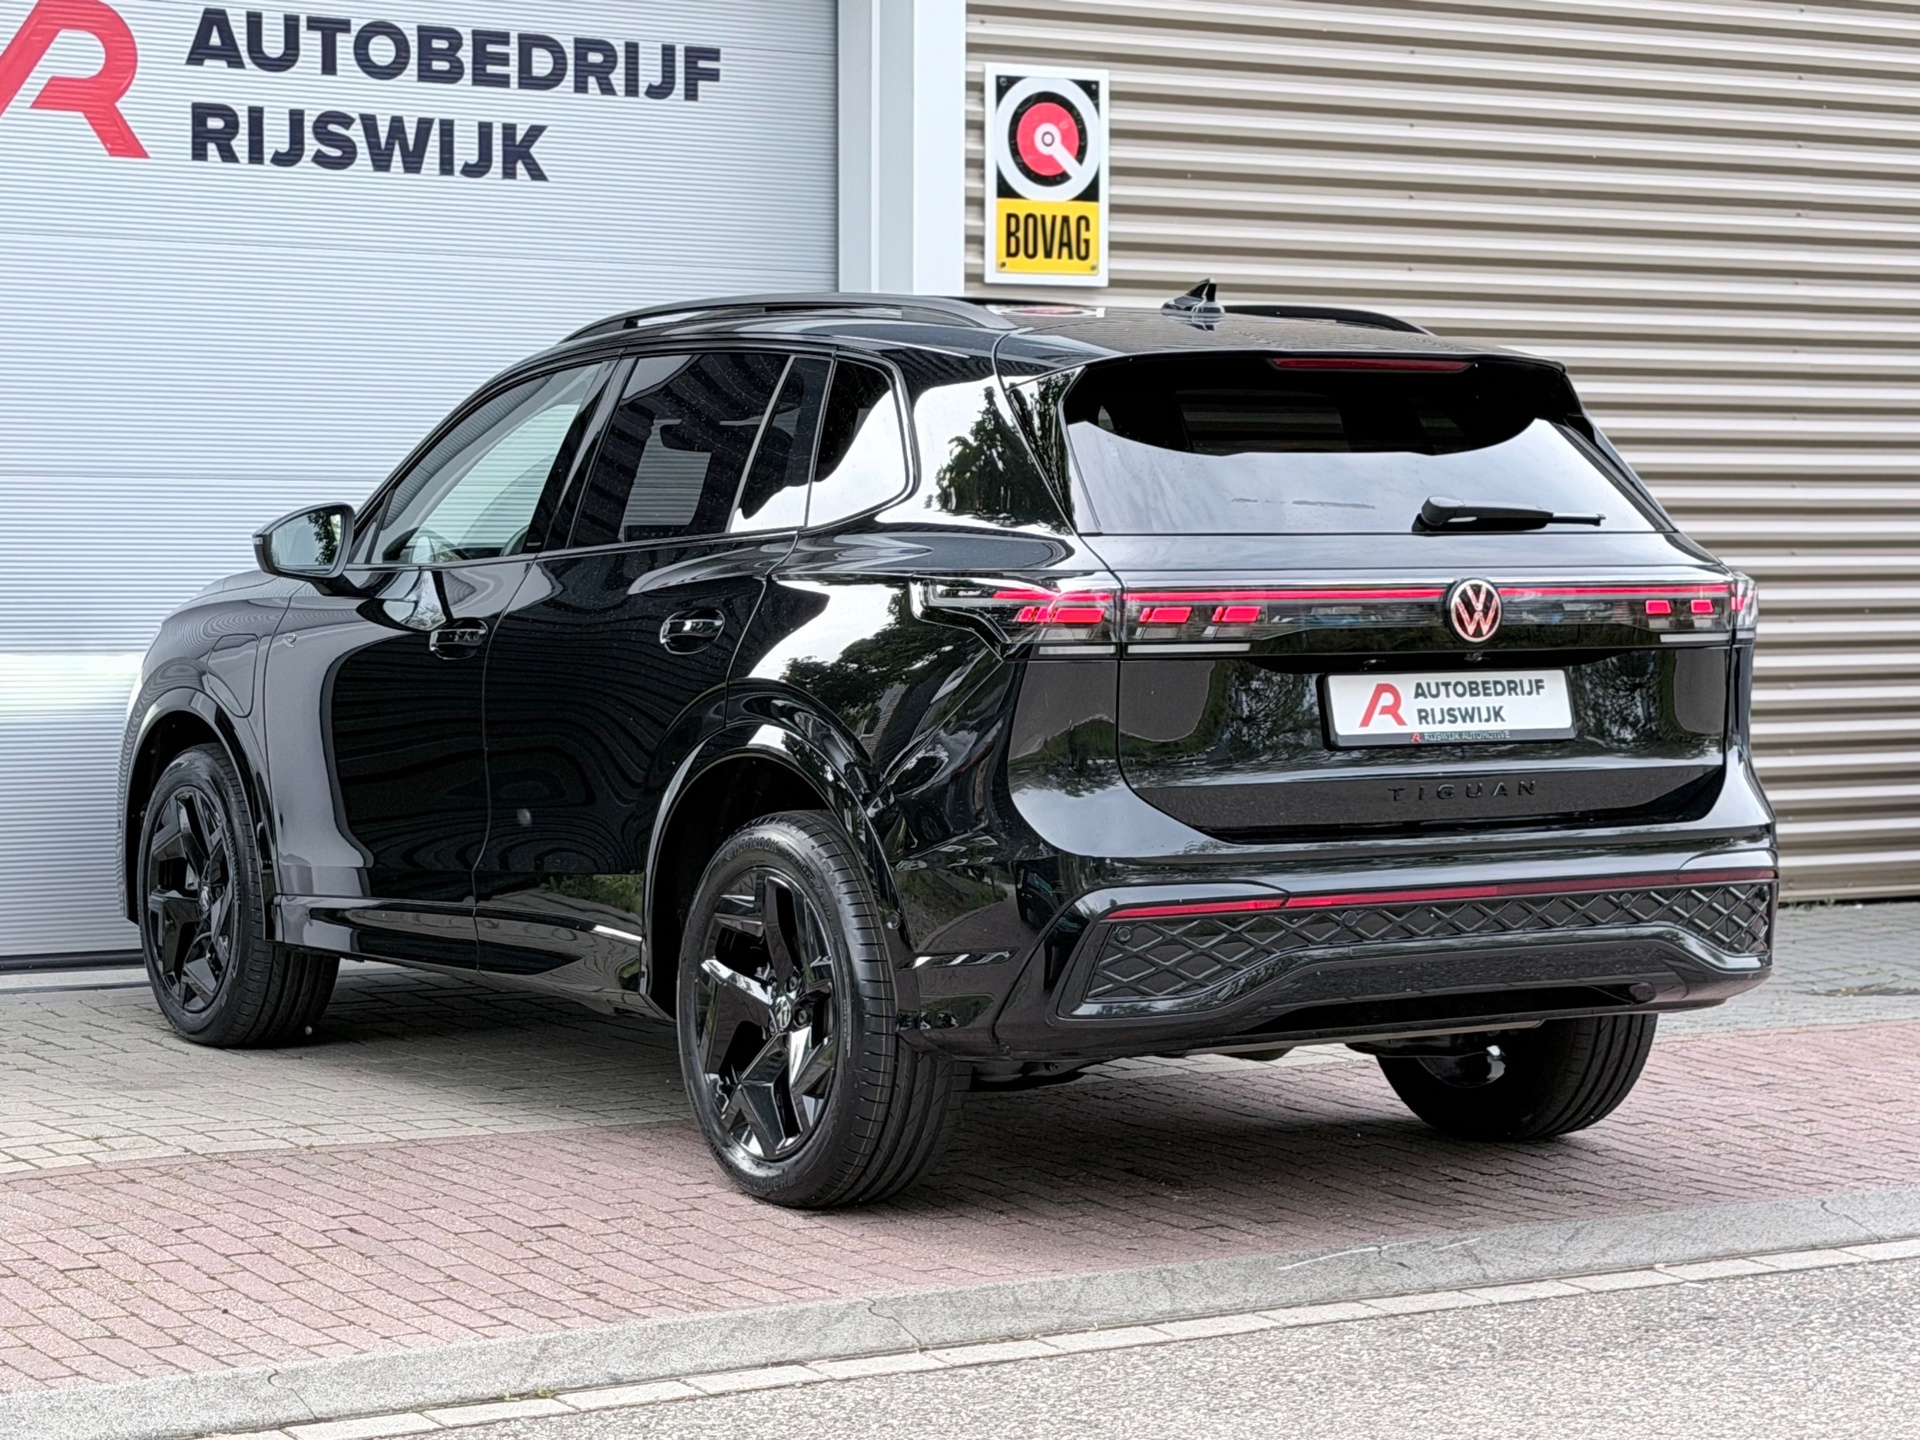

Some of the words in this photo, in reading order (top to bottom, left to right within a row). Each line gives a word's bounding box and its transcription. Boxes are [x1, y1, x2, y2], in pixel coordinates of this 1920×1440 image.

[185, 8, 721, 102] AUTOBEDRIJF
[190, 102, 549, 182] RIJSWIJK
[1005, 212, 1091, 261] BOVAG
[1414, 679, 1545, 700] AUTOBEDRIJF
[1417, 706, 1506, 725] RIJSWIJK
[1461, 730, 1511, 740] AUTOMOTIVE
[1388, 780, 1537, 801] TIGUAN
